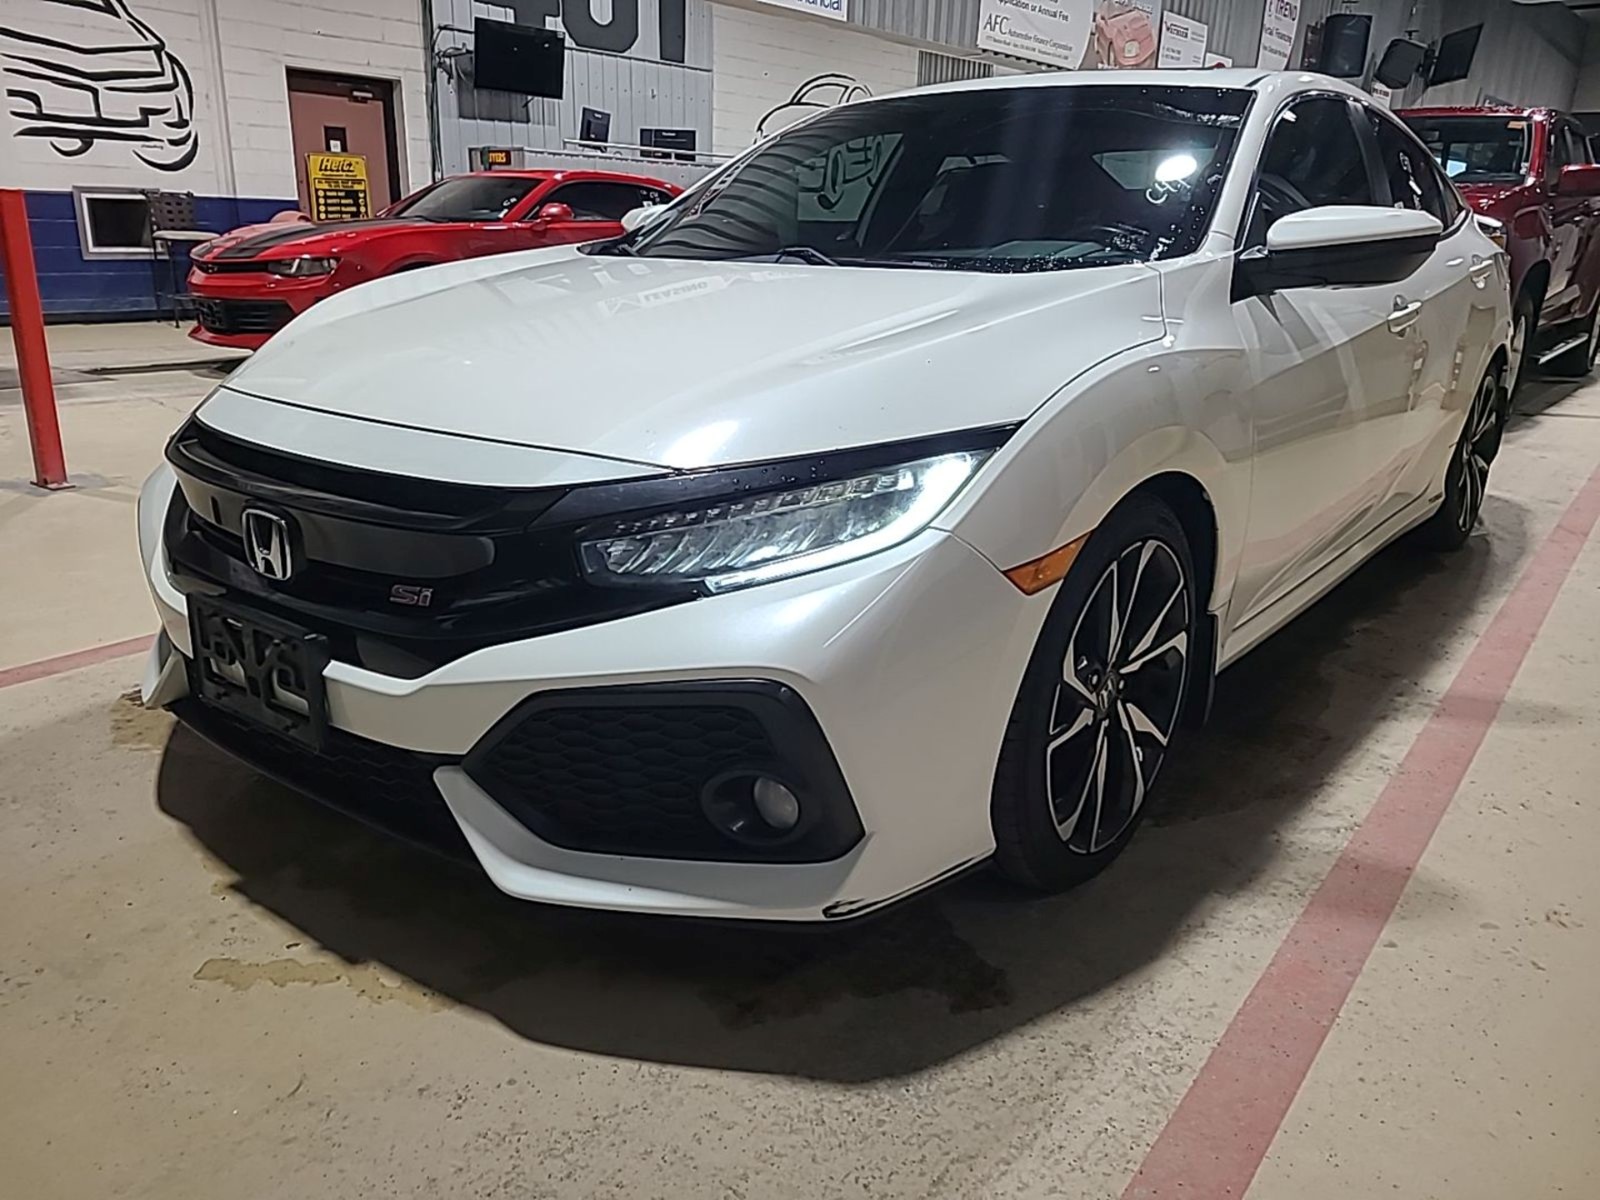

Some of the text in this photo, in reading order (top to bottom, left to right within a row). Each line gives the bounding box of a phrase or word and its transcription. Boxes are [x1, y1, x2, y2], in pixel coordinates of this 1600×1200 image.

[984, 13, 1009, 35] AFC
[319, 158, 355, 172] Hertz
[390, 585, 433, 606] Si
